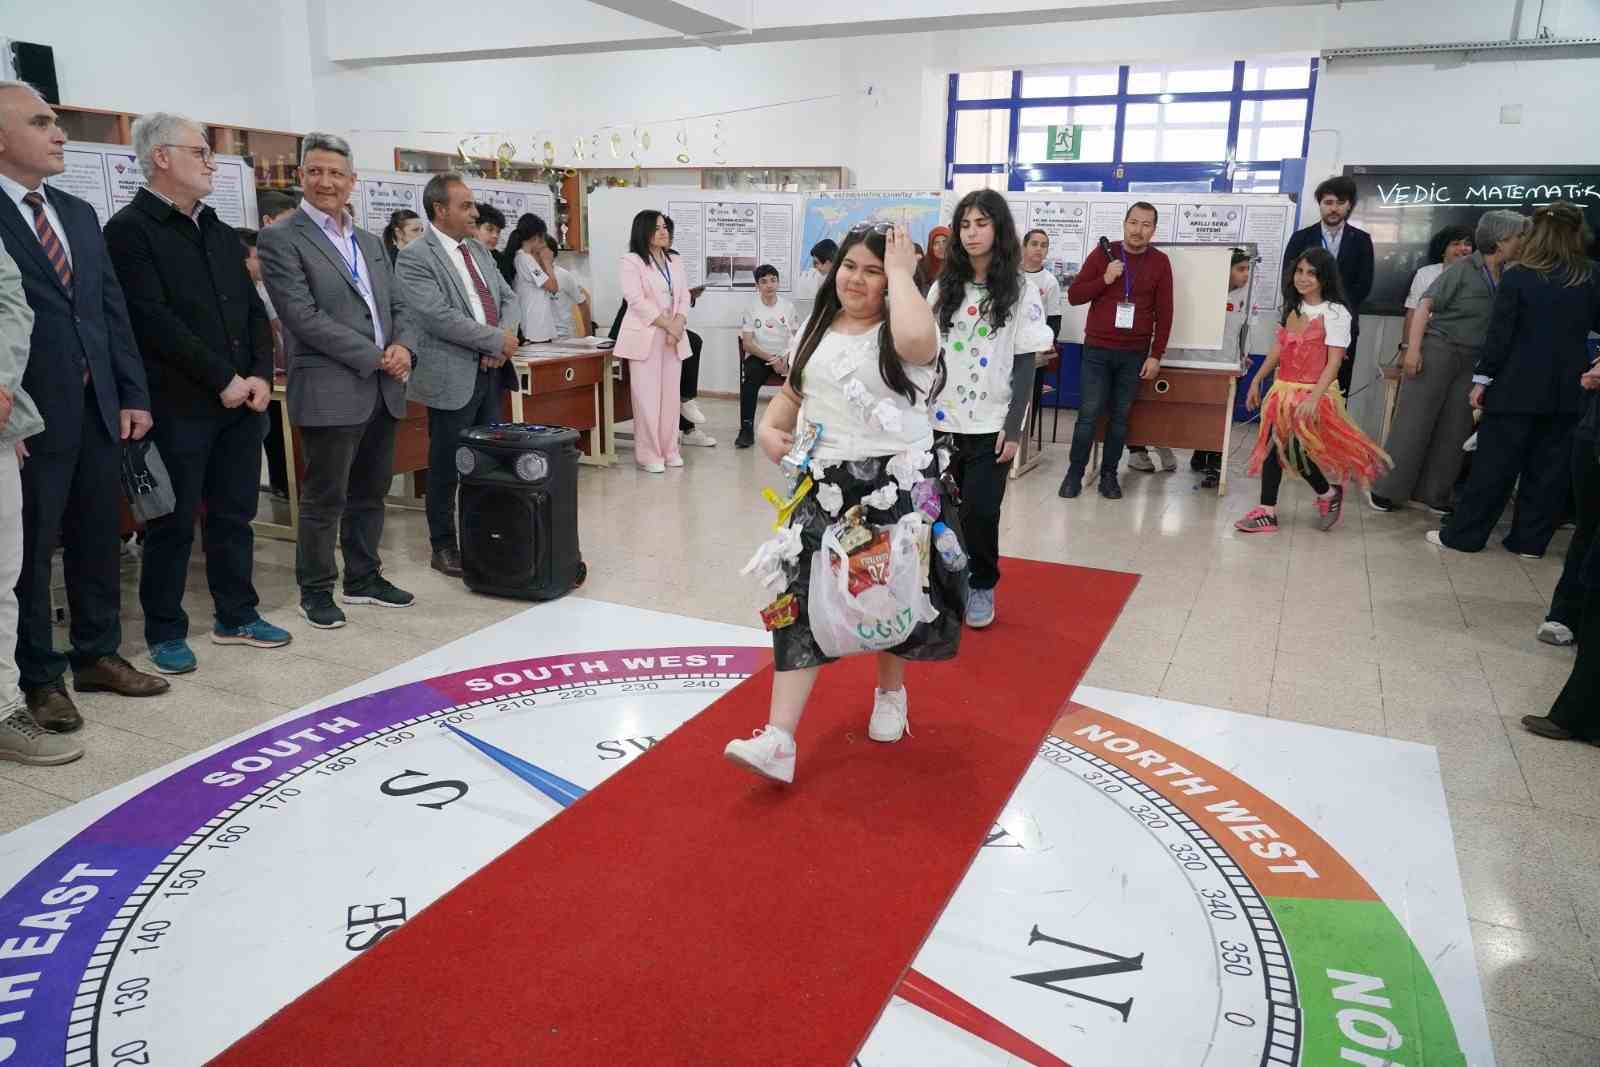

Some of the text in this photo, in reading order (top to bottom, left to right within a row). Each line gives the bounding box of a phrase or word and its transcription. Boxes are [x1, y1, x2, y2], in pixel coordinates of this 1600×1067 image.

[464, 654, 736, 693] SOUTH WEST
[682, 680, 721, 689] 240
[558, 687, 598, 700] 220
[621, 682, 660, 693] 230
[496, 697, 537, 712] 210
[202, 715, 361, 788] SOUTH
[373, 730, 416, 751] 190
[315, 756, 357, 777] 180
[380, 768, 470, 810] S
[1083, 771, 1122, 793] 310
[258, 787, 301, 810] 170
[1073, 723, 1321, 879] NORTH WEST
[1129, 804, 1169, 829] 320
[208, 825, 251, 850] 160
[1169, 843, 1208, 871] 330
[164, 869, 206, 898] 150
[1201, 888, 1237, 921] 340
[130, 920, 171, 954] 140
[1219, 939, 1253, 977] 350
[1010, 923, 1145, 1024] N
[112, 977, 150, 1017] 130
[1224, 1011, 1256, 1028] 0
